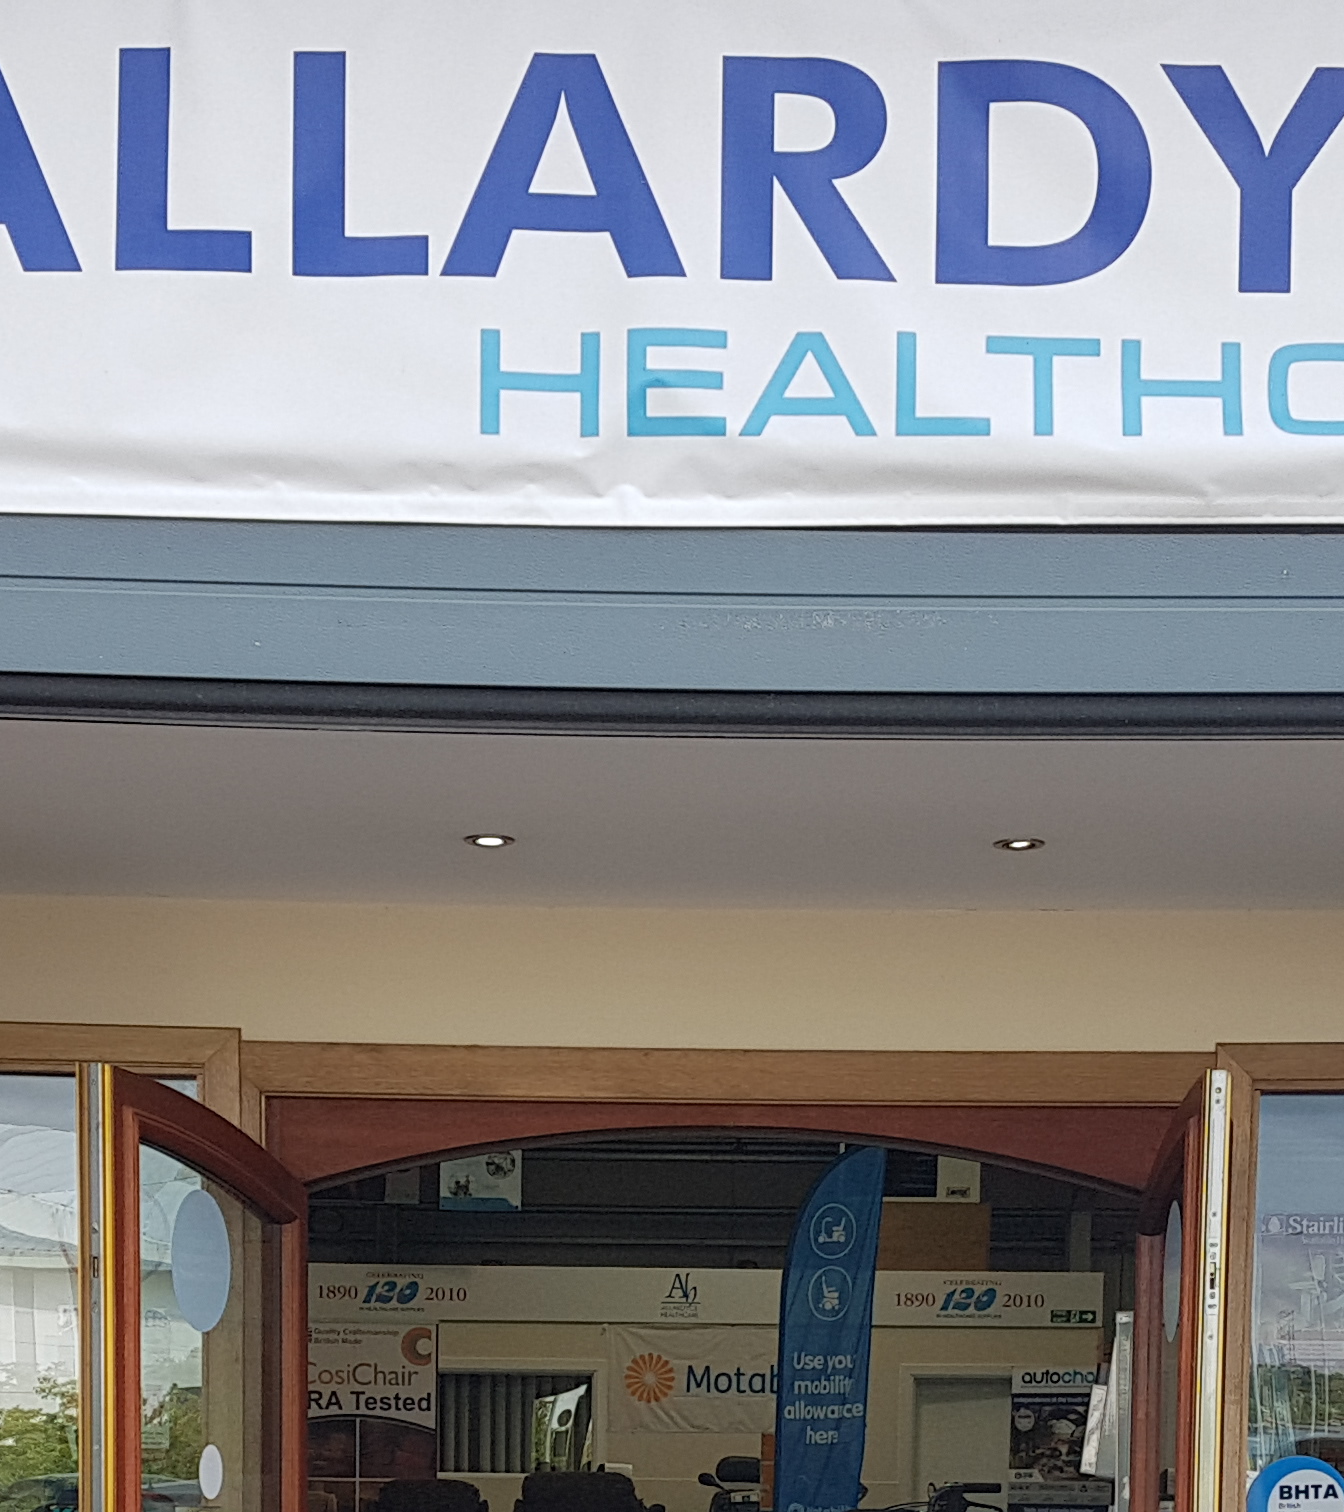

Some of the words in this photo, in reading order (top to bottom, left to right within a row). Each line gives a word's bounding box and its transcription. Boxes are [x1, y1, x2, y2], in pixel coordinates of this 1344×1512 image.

[318, 1284, 358, 1301] 1890
[362, 1280, 420, 1305] 120
[424, 1287, 467, 1302] 2010
[895, 1292, 936, 1307] 1890
[939, 1287, 997, 1312] 120
[1002, 1293, 1045, 1308] 2010
[793, 1352, 824, 1369] Use
[350, 1390, 432, 1412] Tested
[1279, 1484, 1339, 1500] BHTA
